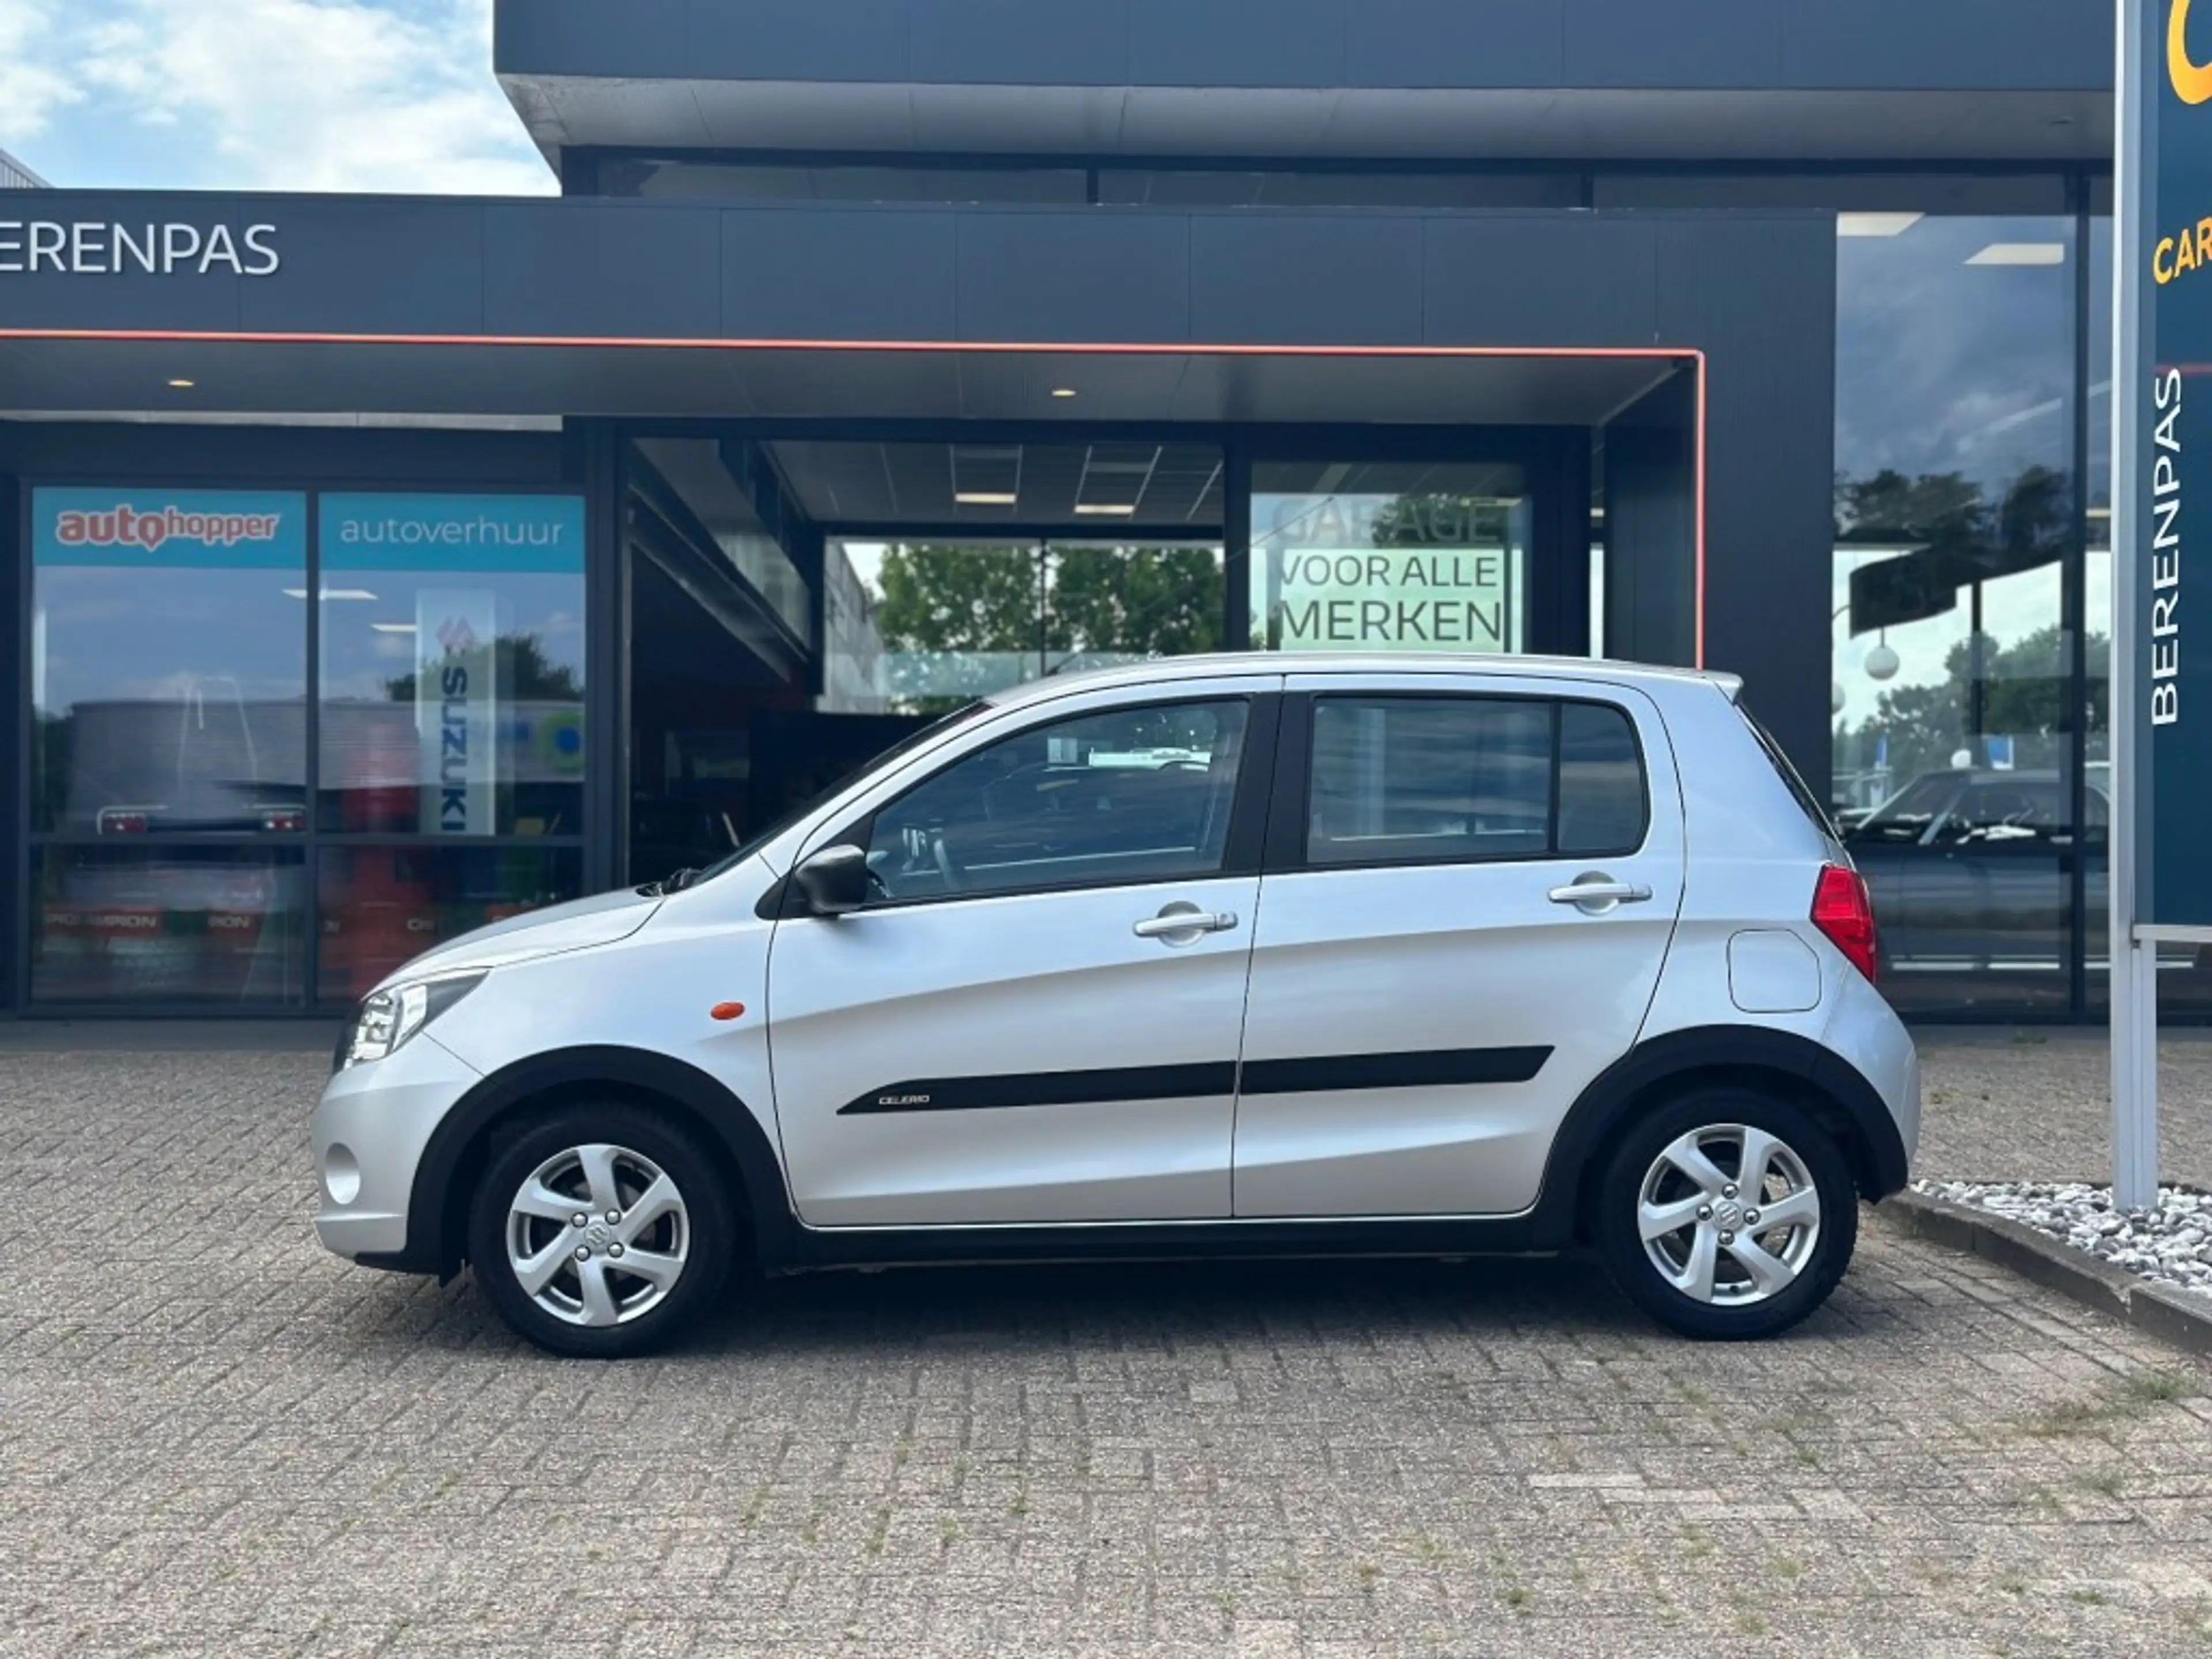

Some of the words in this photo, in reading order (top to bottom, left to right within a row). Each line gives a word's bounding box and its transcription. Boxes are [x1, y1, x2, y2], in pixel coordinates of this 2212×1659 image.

[56, 504, 281, 552] autohopper
[340, 516, 563, 545] autoverhuur
[2152, 368, 2181, 726] BERENPAS
[1280, 555, 1390, 586] VOOR
[1400, 556, 1497, 587] ALLE
[1280, 600, 1501, 642] MERKEN
[441, 666, 468, 832] SUZUKI
